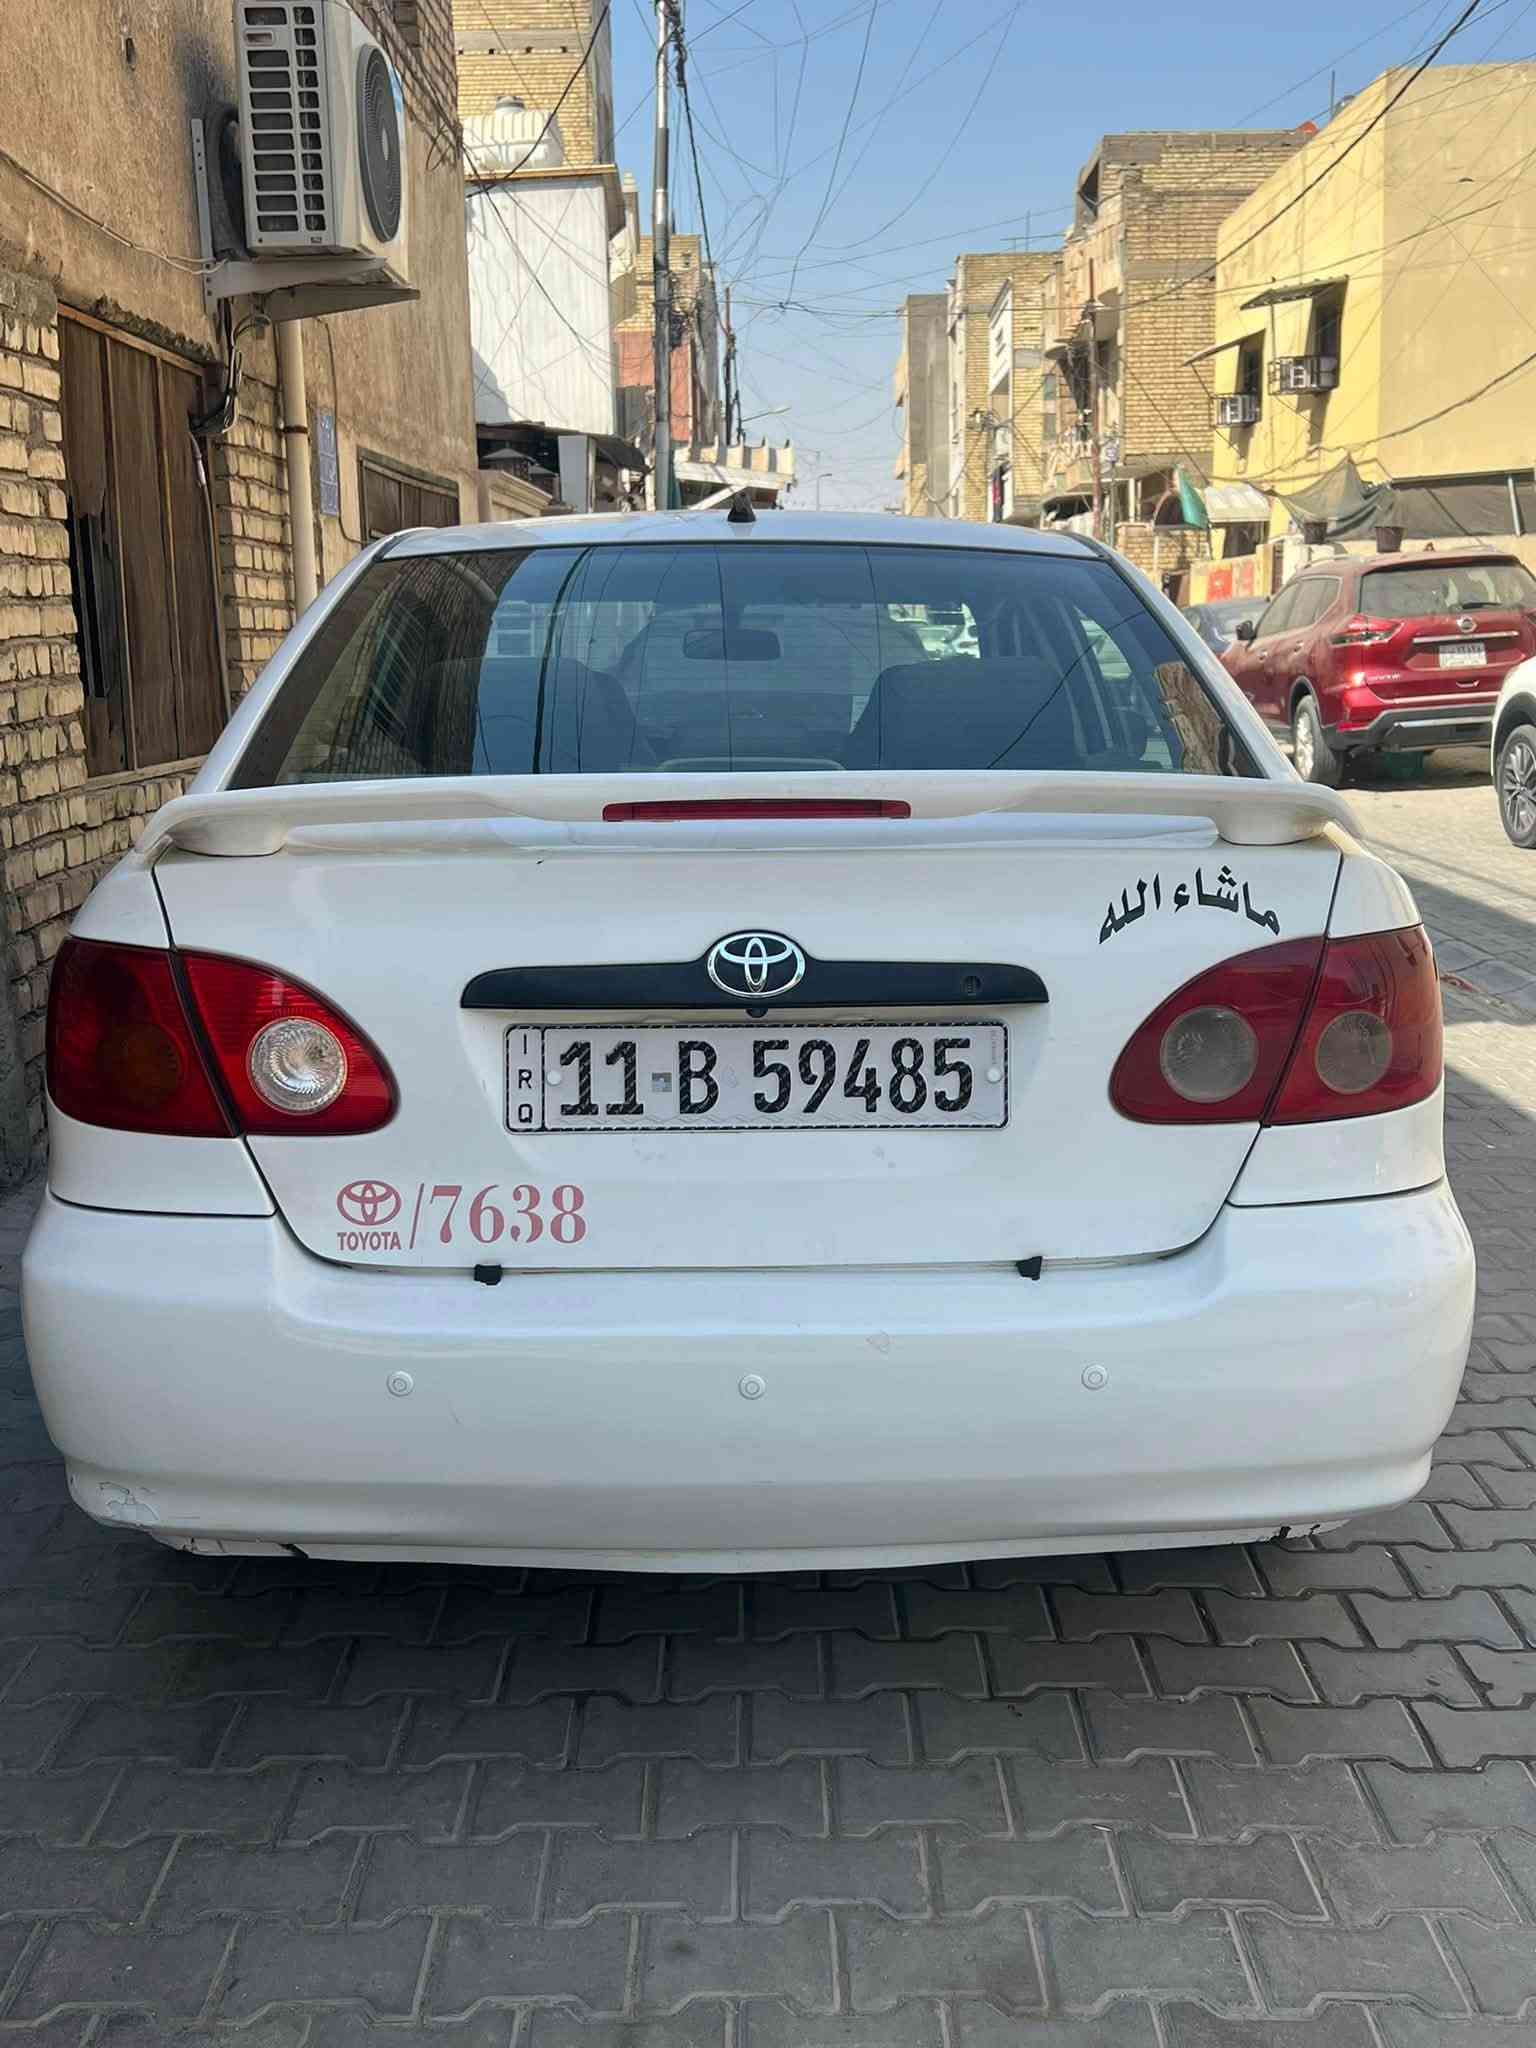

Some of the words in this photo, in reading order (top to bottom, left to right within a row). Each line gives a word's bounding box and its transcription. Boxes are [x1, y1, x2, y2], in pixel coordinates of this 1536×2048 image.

[1098, 872, 1161, 944] الله
[560, 1040, 644, 1116] 11
[678, 1040, 720, 1114] B
[752, 1037, 973, 1113] 59485
[337, 1231, 401, 1251] TOYOTA
